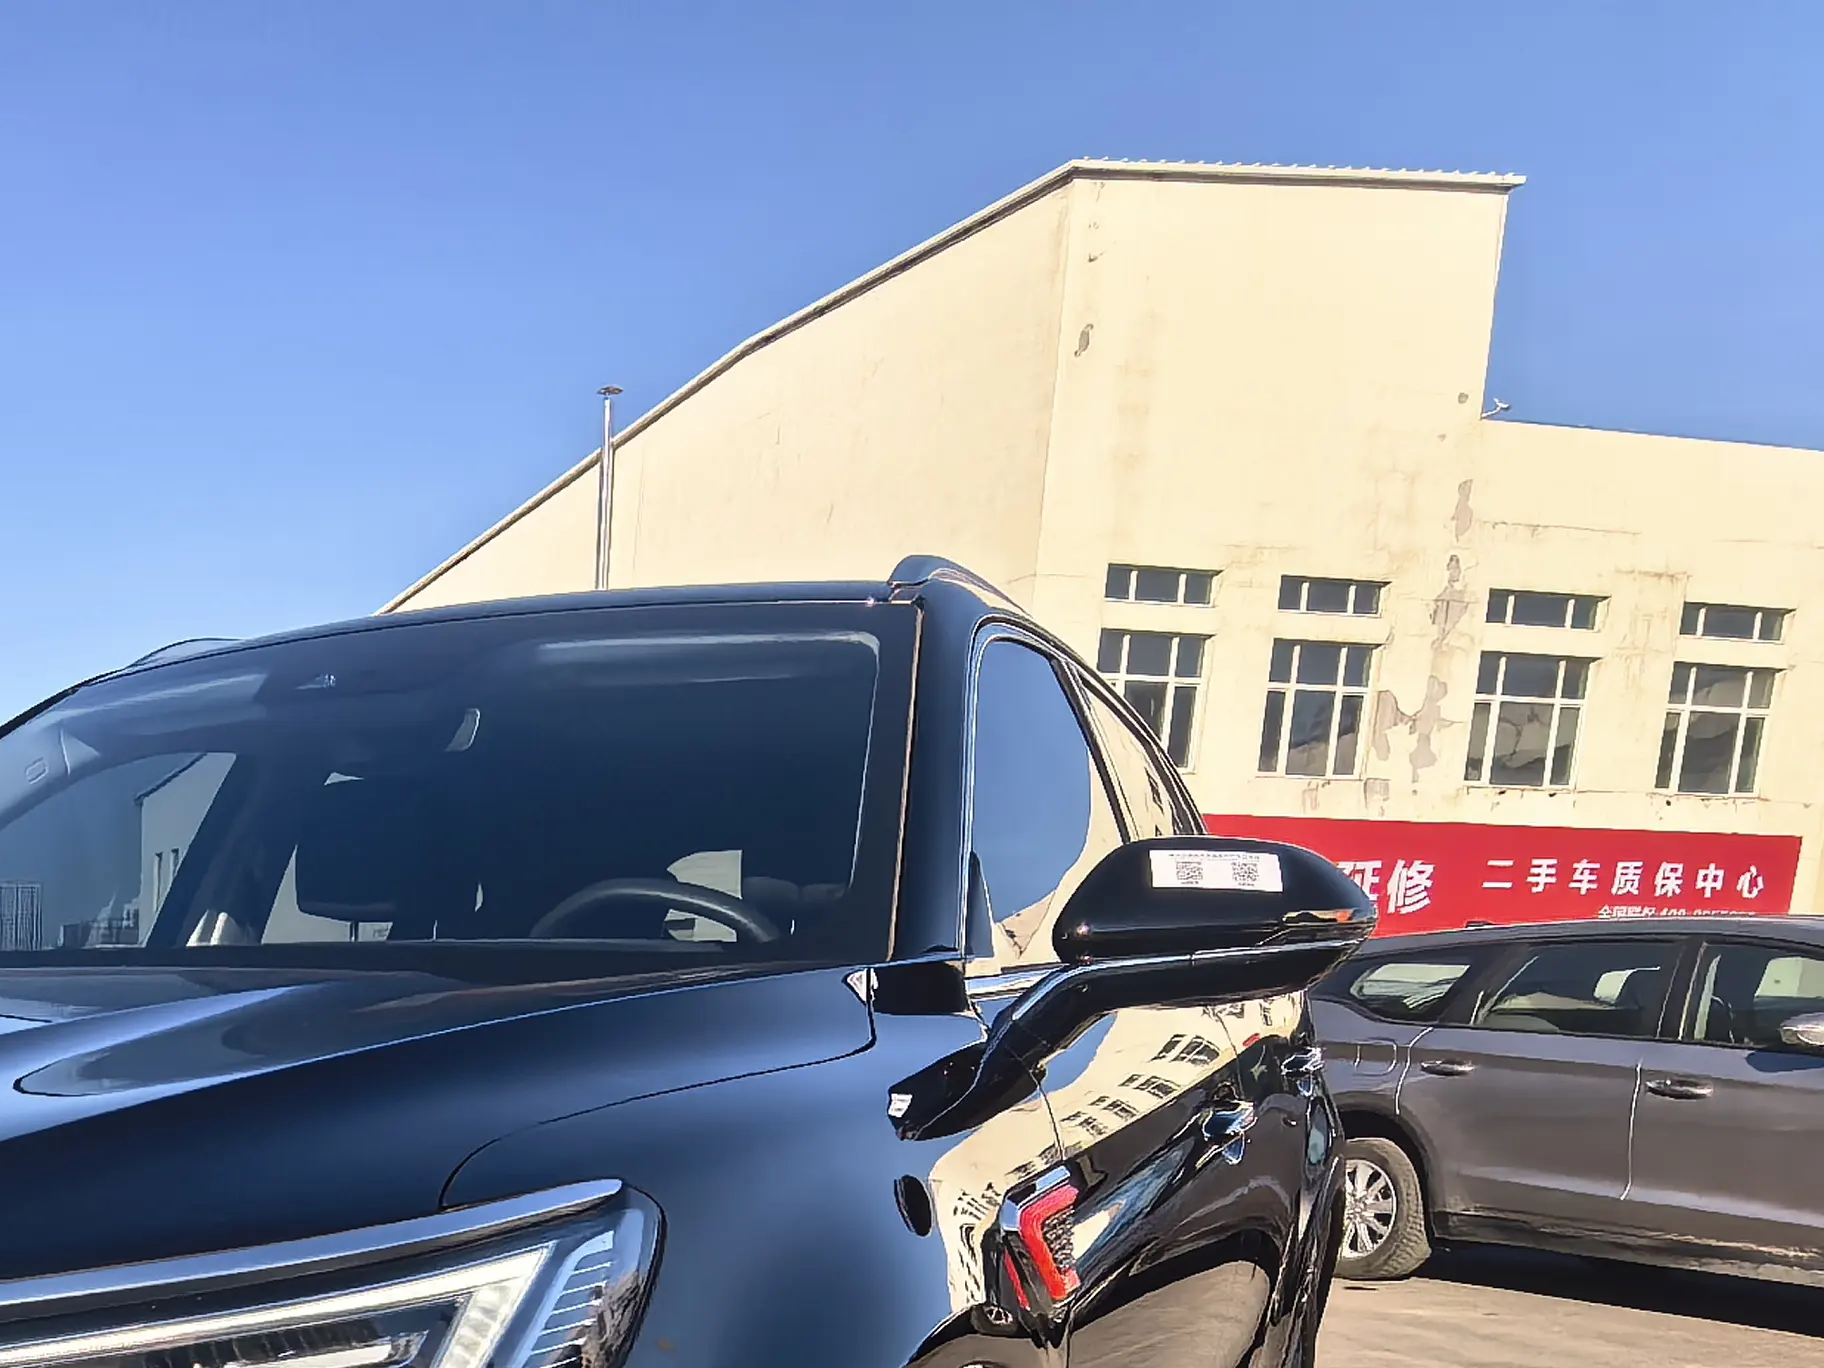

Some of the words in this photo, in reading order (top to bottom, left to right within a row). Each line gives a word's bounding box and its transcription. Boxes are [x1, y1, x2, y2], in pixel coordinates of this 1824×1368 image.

[1482, 857, 1764, 899] 二手车质保中心
